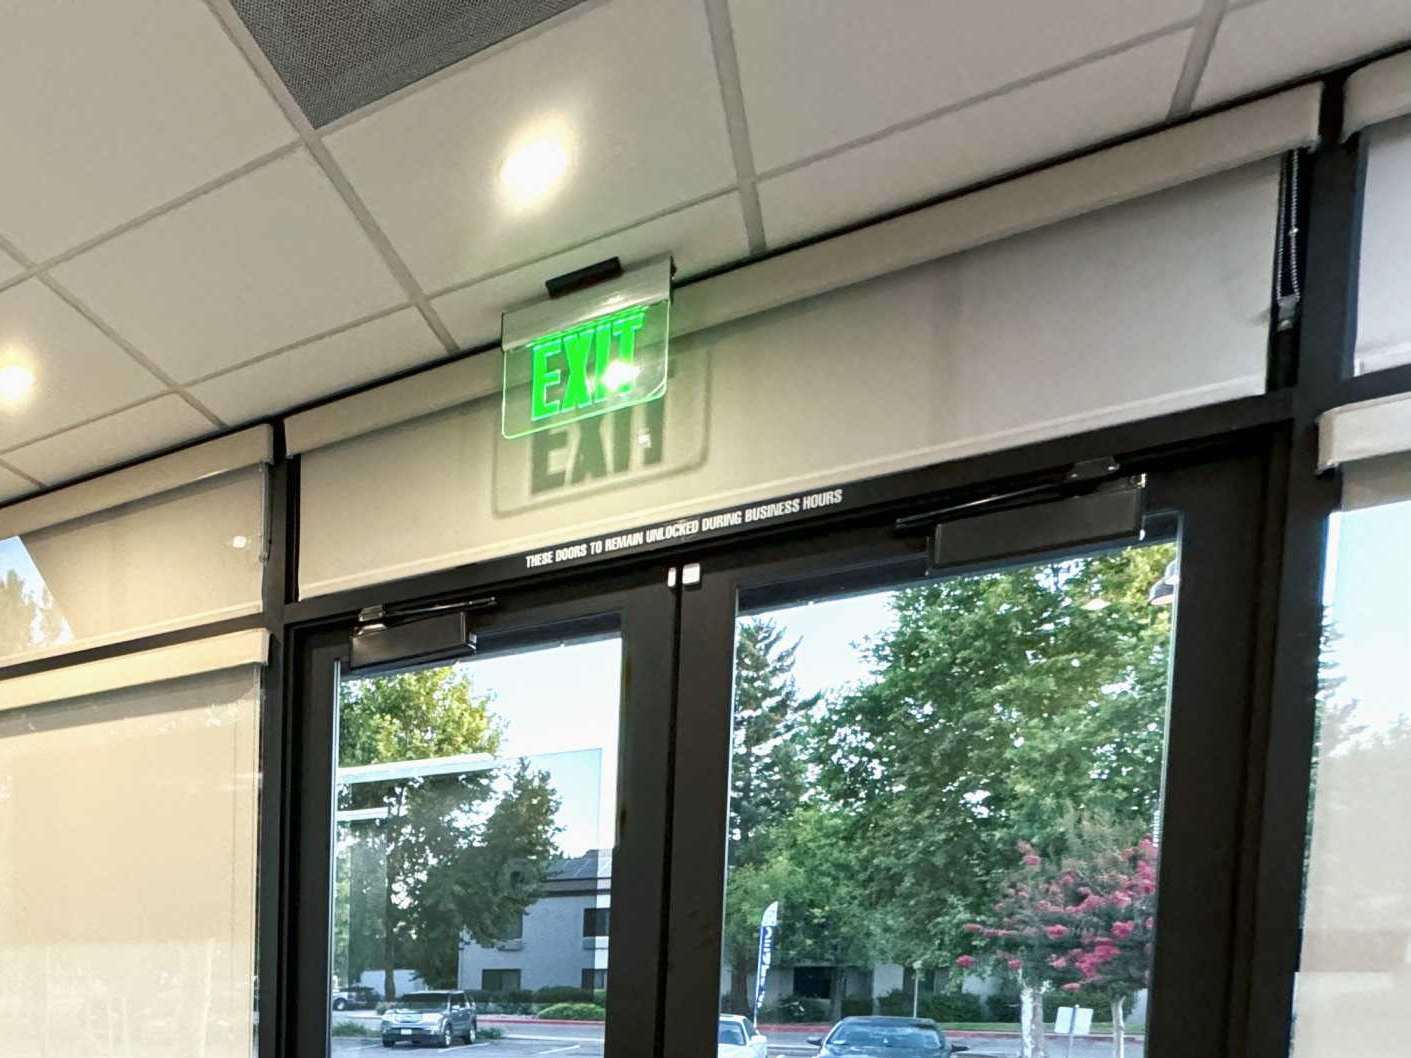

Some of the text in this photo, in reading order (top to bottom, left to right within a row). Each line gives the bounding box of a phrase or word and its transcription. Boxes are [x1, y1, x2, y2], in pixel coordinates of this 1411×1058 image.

[531, 313, 645, 421] EXIT
[525, 488, 843, 569] THESE DOORS TO REMAIN UNLOCKED DURING BUSINESS HOURS
